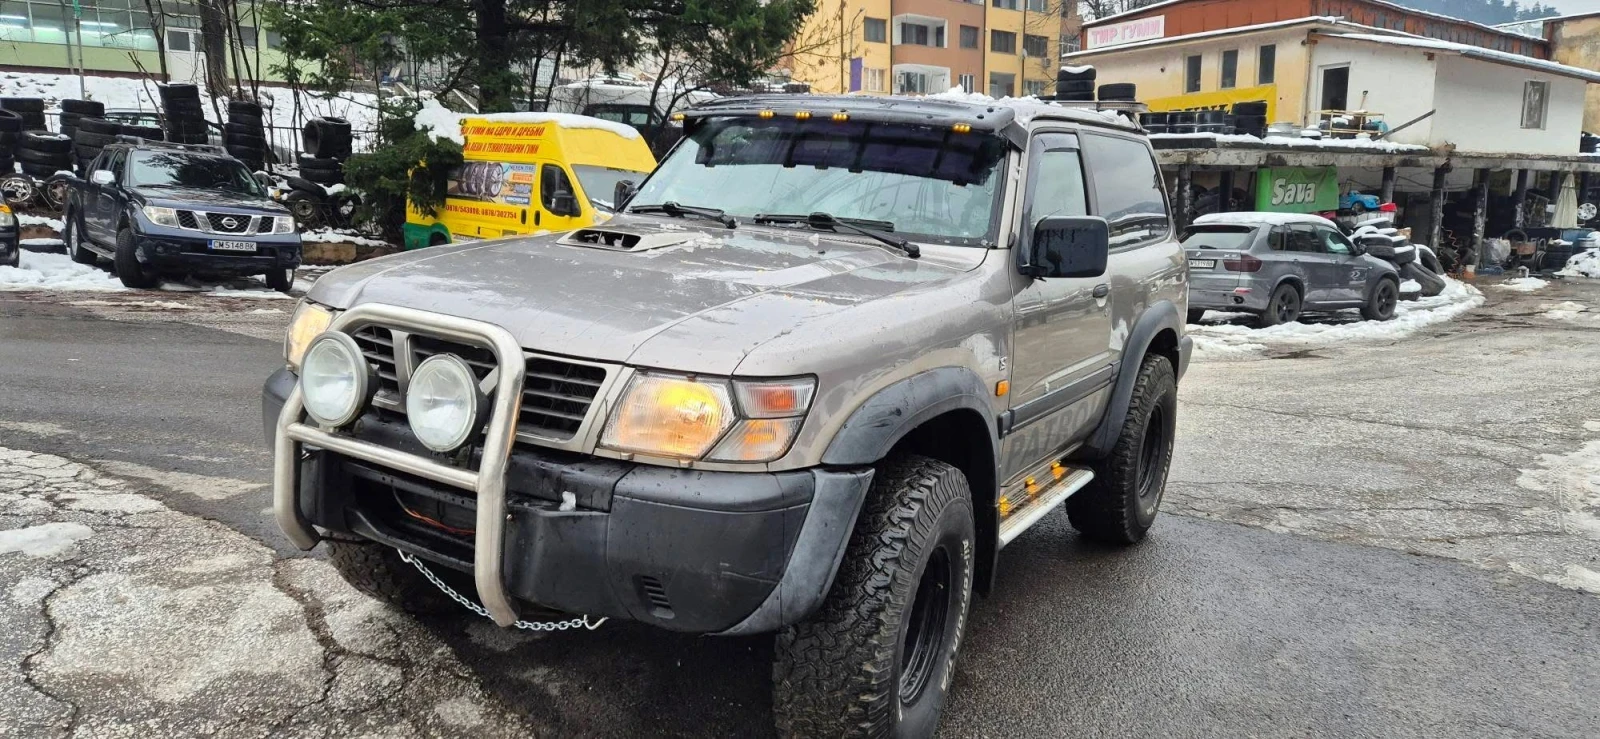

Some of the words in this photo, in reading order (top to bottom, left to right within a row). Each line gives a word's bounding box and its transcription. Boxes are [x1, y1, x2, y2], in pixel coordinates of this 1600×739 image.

[1091, 28, 1118, 44] ТИР
[1120, 20, 1161, 40] ГУМИ
[1271, 177, 1316, 206] Sava
